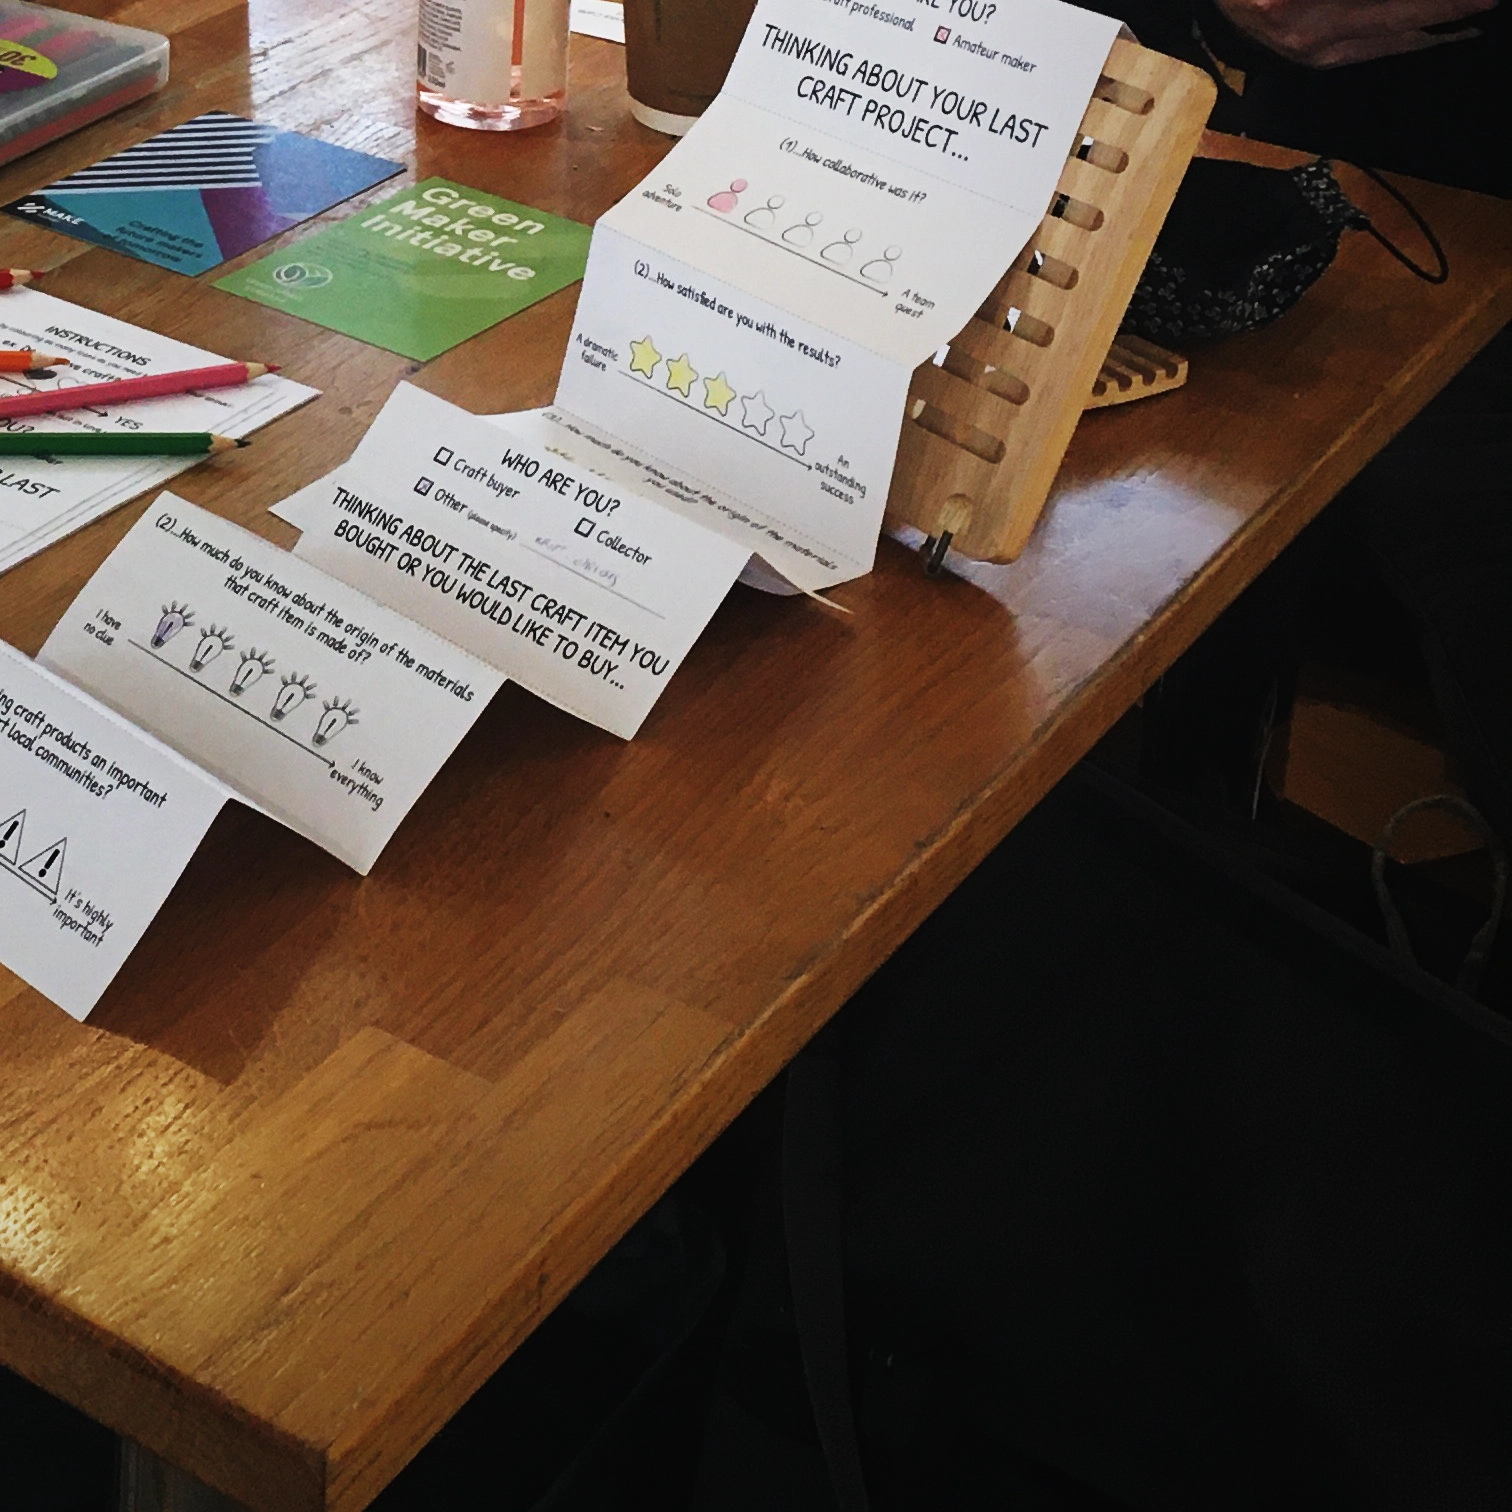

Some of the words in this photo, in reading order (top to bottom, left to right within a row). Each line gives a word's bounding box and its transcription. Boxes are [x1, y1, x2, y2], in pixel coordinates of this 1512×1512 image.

[847, 0, 917, 32] professional
[951, 33, 1001, 60] Amateur
[999, 52, 1038, 73] maker
[760, 22, 854, 77] THINKING
[850, 58, 929, 104] ABOUT
[928, 84, 988, 128] YOUR
[987, 106, 1050, 148] LAST
[796, 74, 863, 116] CRAFT
[860, 97, 969, 162] PROJECT...
[820, 157, 888, 191] collaborative
[886, 183, 909, 199] was
[907, 189, 928, 203] it?
[43, 208, 85, 225] MAKE
[389, 200, 519, 247] Maker
[422, 187, 545, 235] Green
[116, 226, 154, 243] future
[156, 240, 203, 259] makers
[118, 238, 182, 263] tomorrow
[129, 220, 177, 241] Crafting
[180, 235, 204, 249] the
[360, 214, 536, 280] Initiative
[893, 302, 924, 319] quest
[900, 287, 912, 299] A
[910, 291, 936, 310] team
[43, 324, 152, 367] INSTRUCTIONS
[574, 331, 583, 344] A
[582, 335, 619, 362] dramatic
[675, 283, 717, 311] satisfied
[715, 302, 734, 320] are
[734, 311, 754, 329] you
[754, 320, 777, 340] with
[777, 327, 796, 349] the
[796, 340, 842, 368] results?
[580, 348, 607, 372] failure
[452, 457, 489, 483] Craft
[484, 472, 521, 499] buyer
[499, 447, 540, 478] WHO
[536, 467, 576, 496] ARE
[572, 481, 621, 517] YOU?
[813, 461, 867, 499] outstanding
[835, 453, 850, 469] An
[433, 487, 469, 514] Other
[819, 480, 855, 505] success
[595, 529, 653, 566] Collector
[331, 485, 404, 536] THINKING
[397, 523, 460, 564] ABOUT
[455, 551, 492, 582] THE
[484, 568, 534, 603] LAST
[529, 592, 589, 632] CRAFT
[582, 620, 631, 657] ITEM
[628, 641, 671, 676] YOU
[94, 607, 104, 619] I
[99, 609, 122, 631] have
[198, 541, 231, 564] much
[227, 554, 244, 572] do
[239, 564, 265, 584] you
[261, 572, 293, 600] know
[290, 591, 327, 617] about
[322, 607, 345, 628] the
[342, 622, 380, 649] origin
[378, 641, 399, 656] of
[394, 646, 416, 669] the
[413, 662, 475, 702] materials
[222, 573, 251, 597] that
[246, 590, 281, 614] craft
[275, 604, 305, 630] item
[302, 620, 318, 637] is
[314, 630, 348, 655] made
[346, 647, 372, 665] of?
[332, 517, 400, 564] BOUGHT
[395, 551, 423, 577] OR
[420, 562, 459, 594] YOU
[454, 581, 513, 626] WOULD
[510, 612, 555, 647] LIKE
[551, 632, 580, 660] TO
[576, 647, 625, 690] BUY...
[82, 621, 96, 635] no
[93, 627, 115, 646] clue
[5, 721, 39, 752] local
[33, 744, 114, 800] communities?
[12, 703, 47, 730] craft
[38, 721, 92, 761] products
[89, 753, 108, 772] an
[104, 759, 168, 809] important
[349, 757, 360, 770] I
[356, 760, 384, 786] know
[328, 767, 384, 812] everything
[51, 903, 105, 948] important
[63, 887, 84, 909] It's
[80, 898, 115, 933] highly
